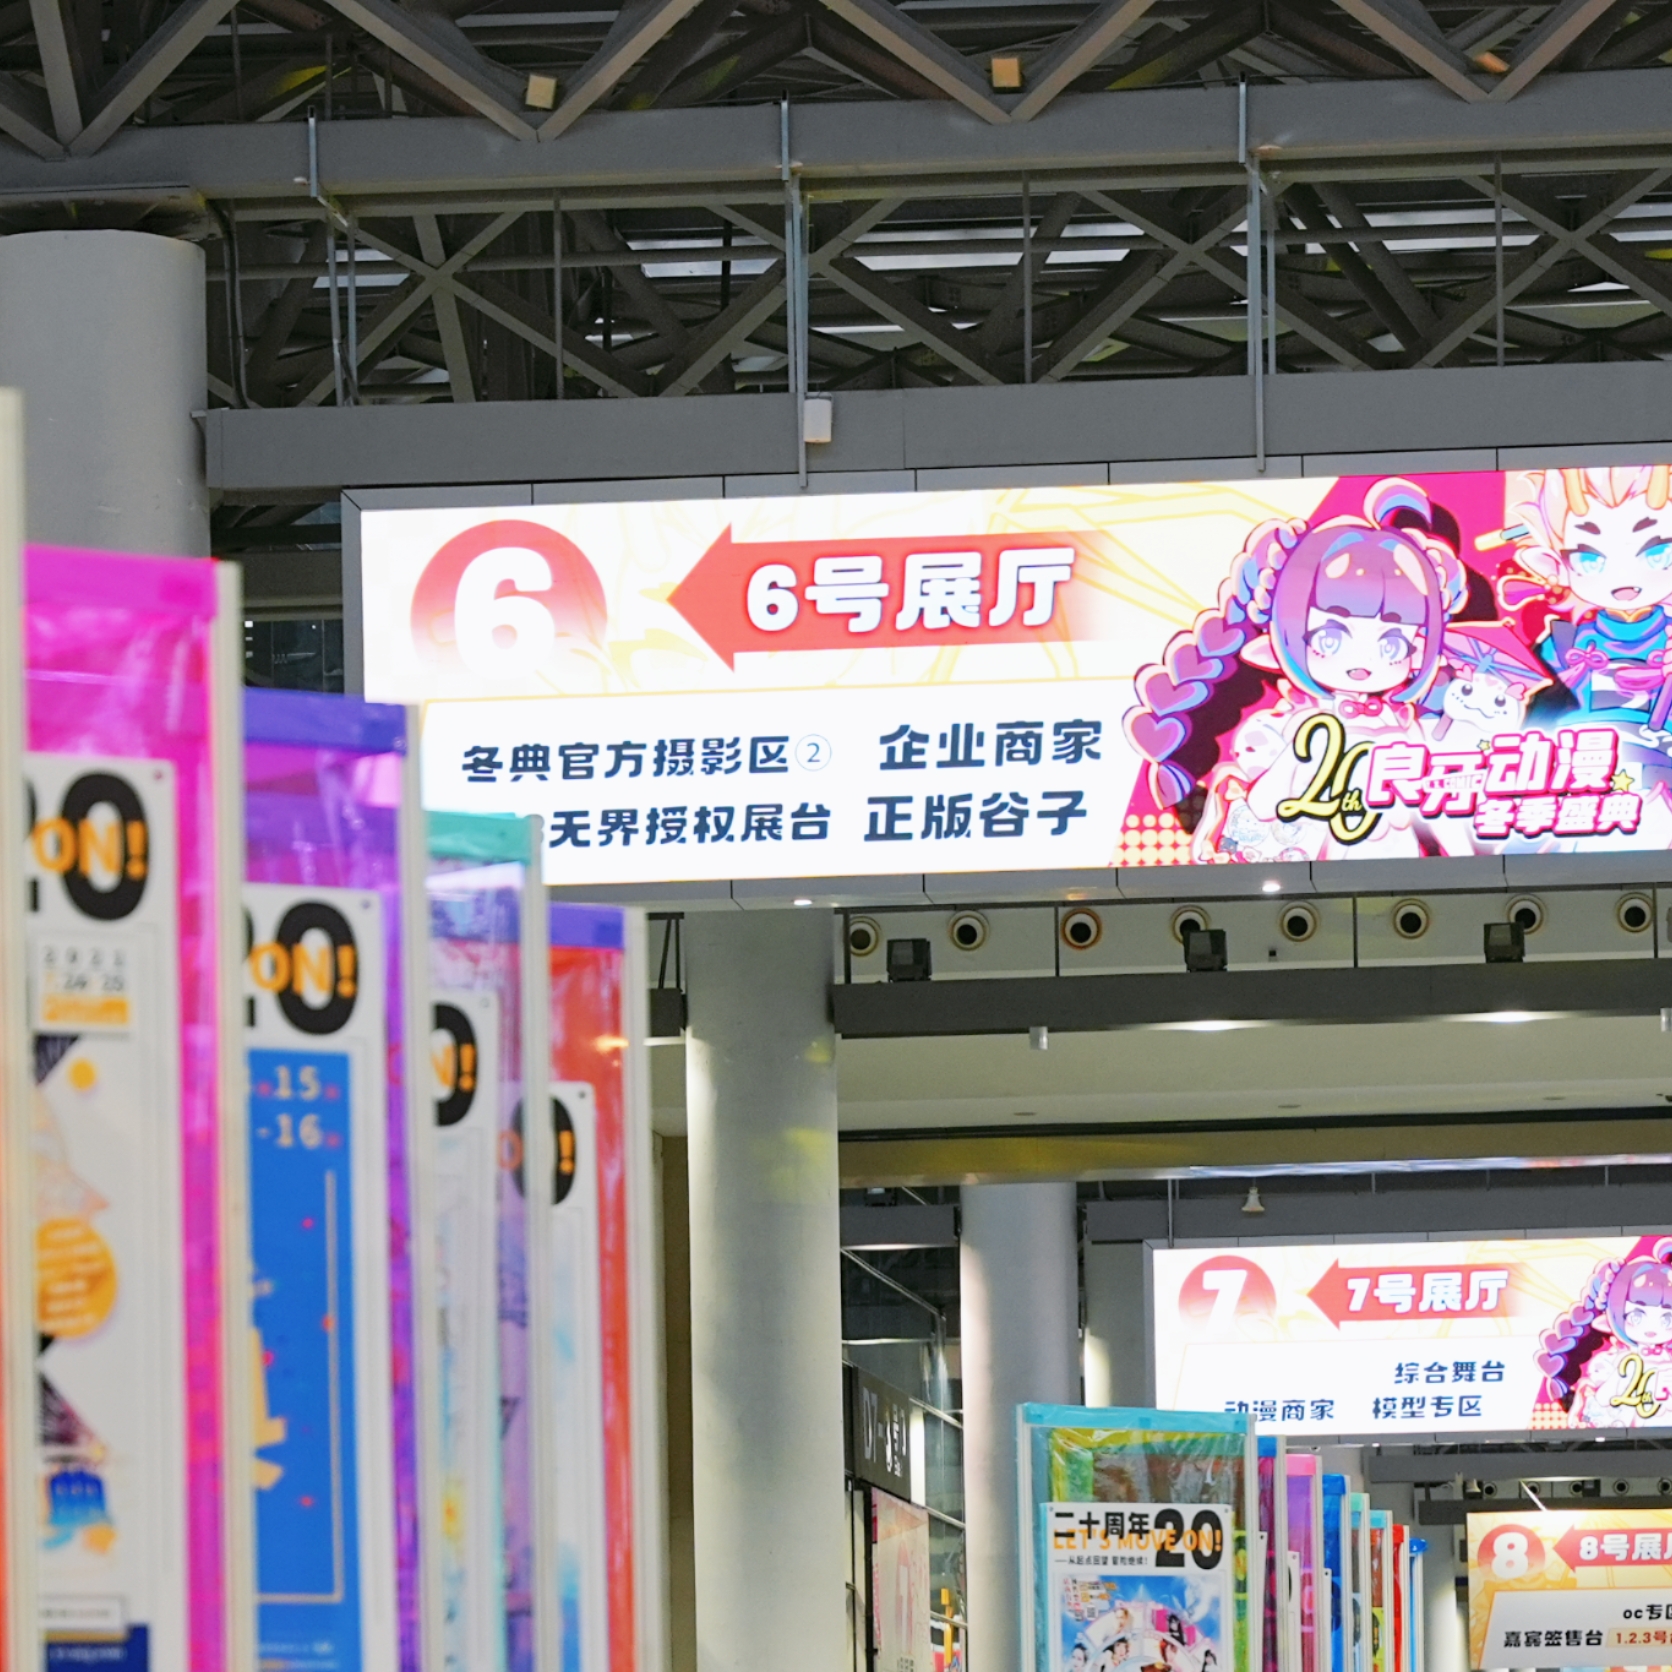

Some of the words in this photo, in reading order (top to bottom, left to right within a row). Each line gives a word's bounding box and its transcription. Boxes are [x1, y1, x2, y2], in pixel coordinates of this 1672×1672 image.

[454, 546, 556, 682] 6
[746, 546, 1076, 633] 6号展厅
[878, 717, 1103, 771] 企业商家
[1364, 728, 1619, 818] 良牙动漫
[539, 802, 832, 848] 无界授权展台
[863, 790, 1088, 842] 正版谷子
[1474, 793, 1643, 838] 冬季盛典
[32, 816, 147, 880] ON!
[249, 939, 359, 999] ON!
[1201, 1268, 1249, 1333] 7
[1345, 1269, 1509, 1314] 7号展厅
[1393, 1360, 1507, 1385] 综合舞台
[1371, 1394, 1484, 1421] 模型专区
[1053, 1528, 1112, 1551] LET'S
[1117, 1528, 1178, 1552] MOVE
[1182, 1529, 1223, 1552] ON!
[1054, 1511, 1151, 1540] 二十周年
[1153, 1507, 1224, 1570] 20
[1491, 1531, 1529, 1580] 8
[1503, 1628, 1604, 1649] 嘉宾签售台
